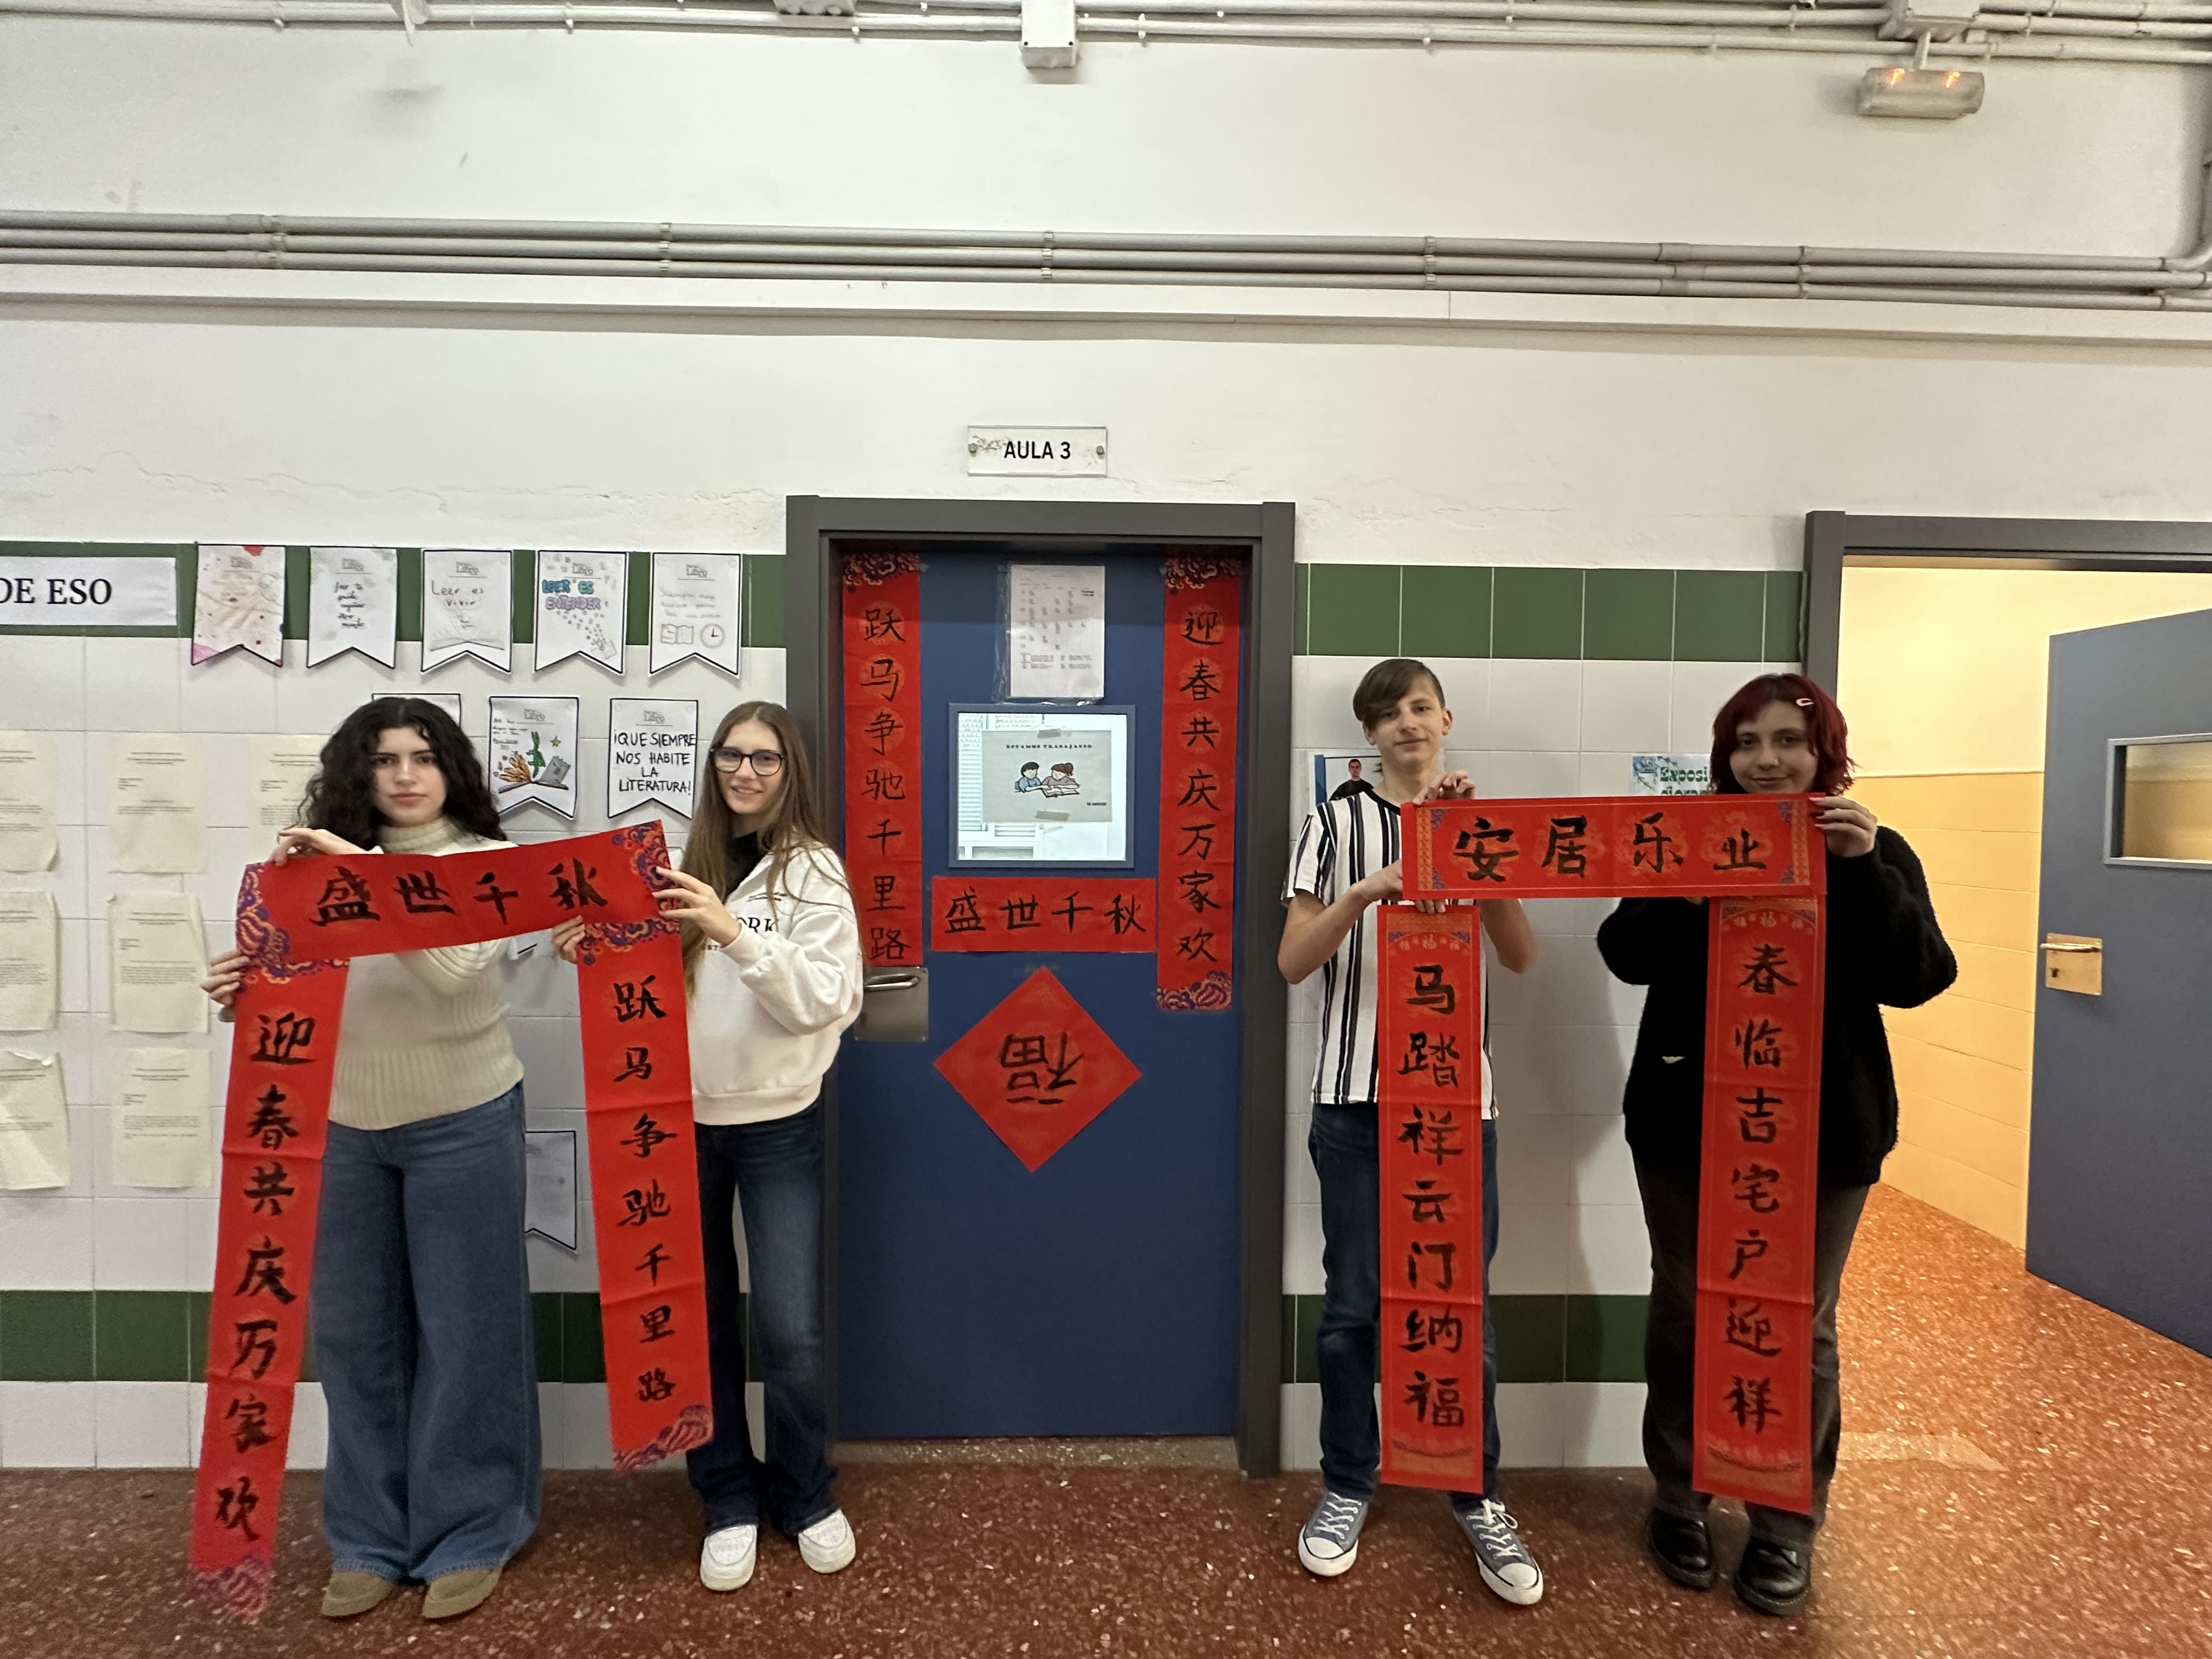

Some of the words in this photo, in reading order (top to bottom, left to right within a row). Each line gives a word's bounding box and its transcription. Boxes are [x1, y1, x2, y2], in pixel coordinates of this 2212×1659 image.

[1003, 441, 1054, 459] AULA
[1059, 441, 1071, 460] 3
[46, 578, 112, 605] ESO
[431, 579, 460, 596] Leer
[541, 579, 571, 594] LEER
[578, 580, 595, 595] ES
[545, 595, 601, 611] ENTENDER
[616, 751, 642, 765] NOS
[648, 752, 691, 766] HABITE
[649, 732, 696, 748] SIEMPRE
[641, 766, 659, 778] LA
[860, 608, 912, 961] 跃马争驰千里路
[1176, 611, 1224, 963] 迎春共庆万家欢
[1453, 811, 1768, 882] 安居乐业
[309, 857, 608, 927] 盛世千秋
[944, 885, 1147, 935] 盛世千秋
[1000, 1032, 1085, 1105] 福
[613, 974, 679, 1402] 跃马争驰千里路
[1397, 964, 1464, 1427] 马踏祥云门纳福
[1724, 944, 1799, 1434] 春临吉宅户迎祥
